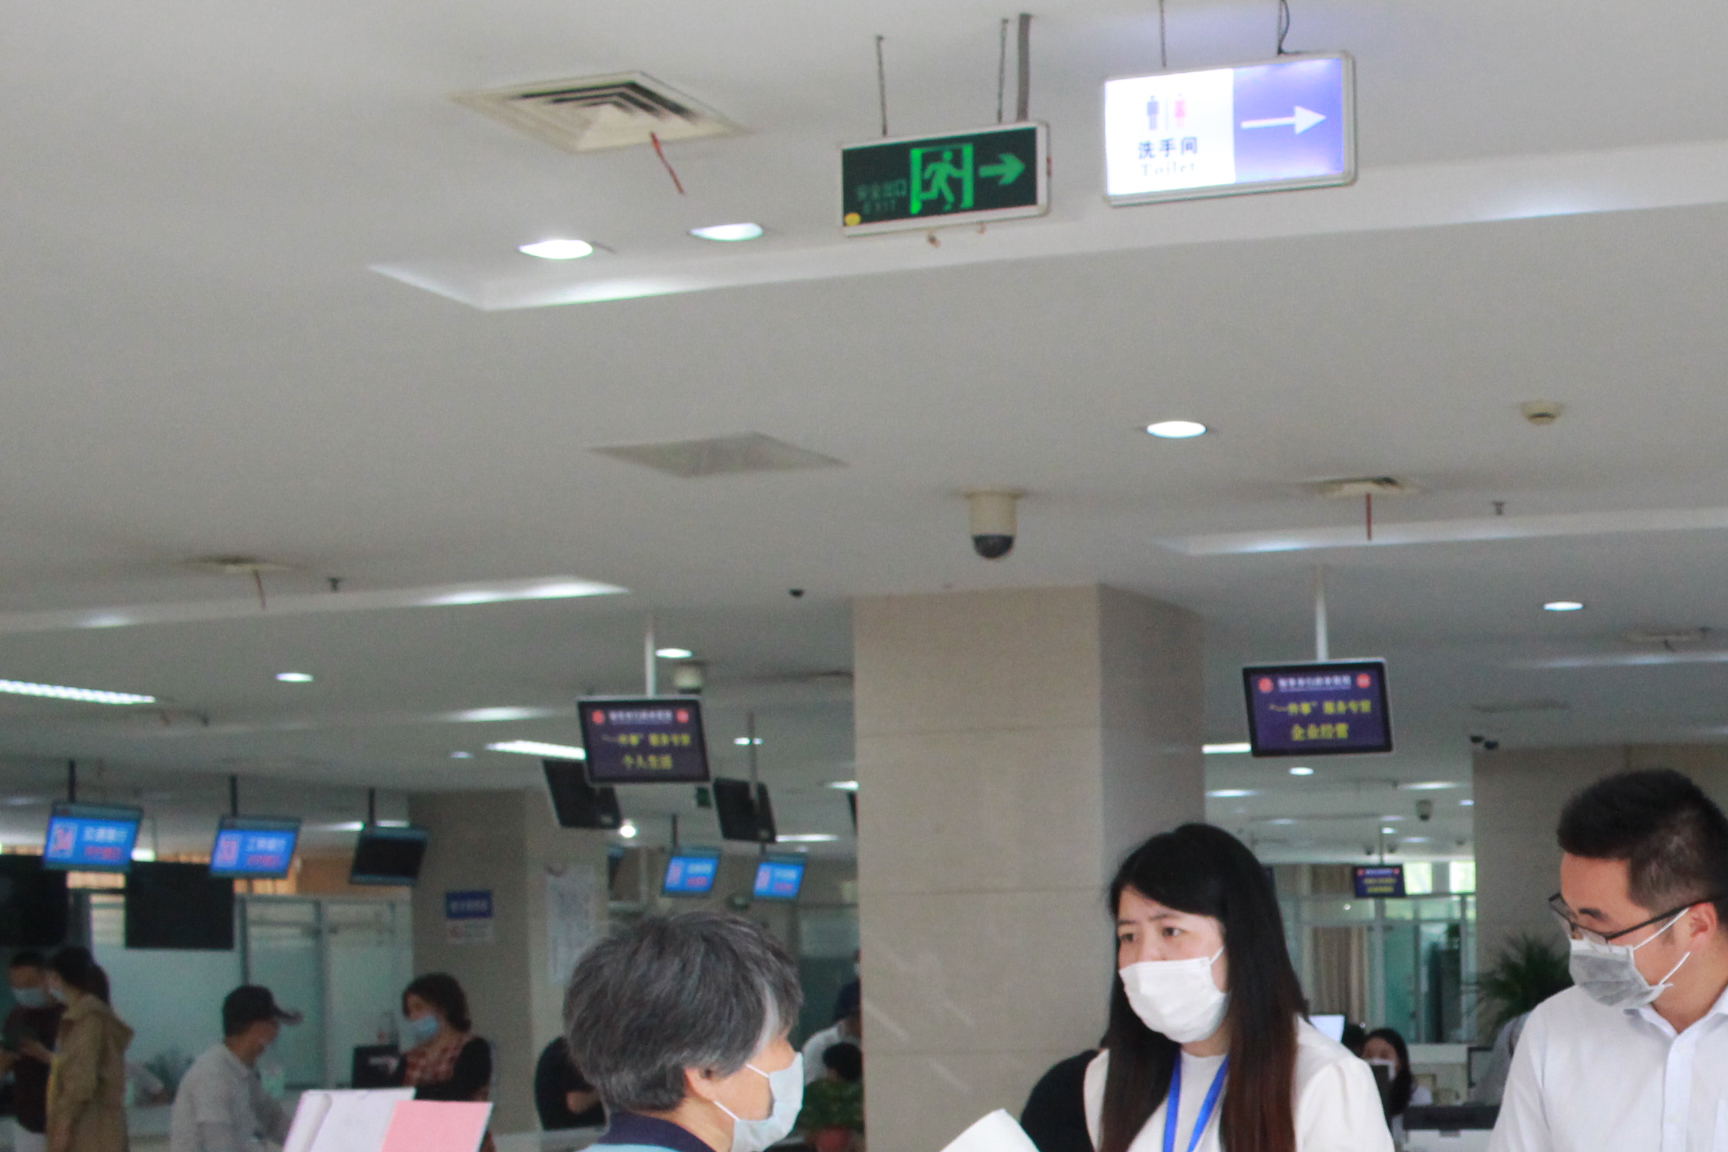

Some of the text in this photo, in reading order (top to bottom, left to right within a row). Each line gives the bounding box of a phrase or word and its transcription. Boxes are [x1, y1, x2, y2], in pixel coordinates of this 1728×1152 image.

[1138, 136, 1198, 160] 洗手间
[1141, 161, 1197, 176] Toilet
